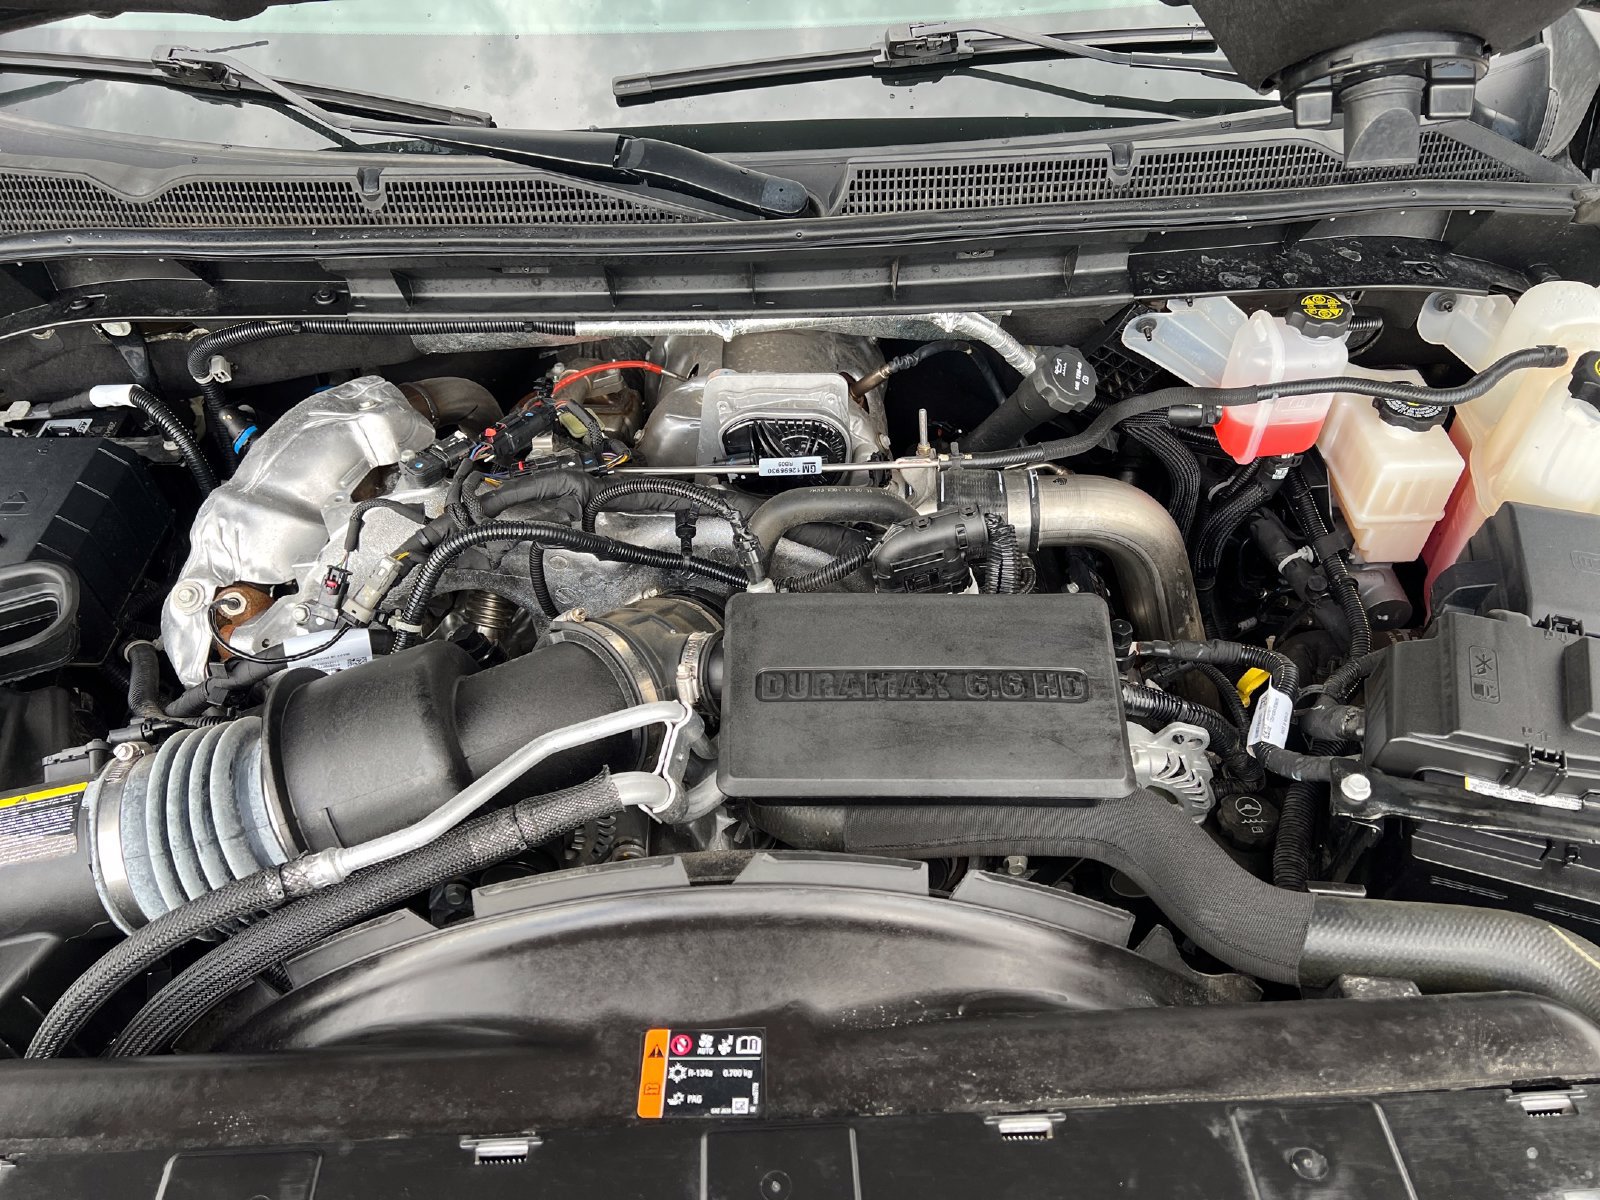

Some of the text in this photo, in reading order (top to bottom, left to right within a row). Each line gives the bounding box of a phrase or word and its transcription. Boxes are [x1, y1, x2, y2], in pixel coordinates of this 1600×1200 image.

[802, 464, 817, 474] GM
[761, 671, 1085, 700] DURAMAX 6.6 HD
[696, 1047, 715, 1055] AUTO
[687, 1069, 713, 1077] R-134a
[722, 1069, 753, 1078] 0.700 kg
[687, 1095, 702, 1104] PAG
